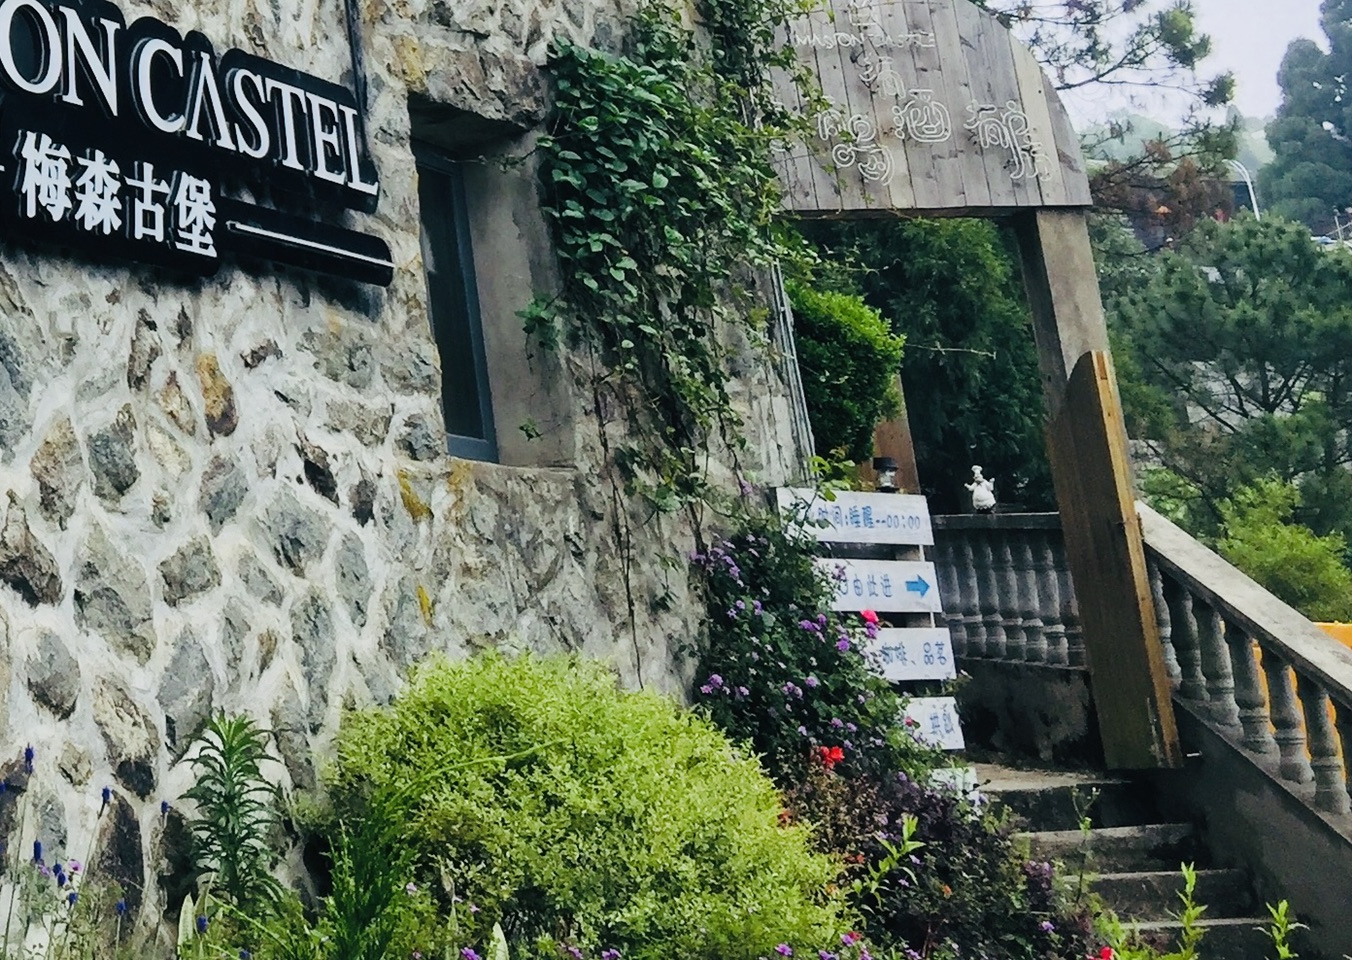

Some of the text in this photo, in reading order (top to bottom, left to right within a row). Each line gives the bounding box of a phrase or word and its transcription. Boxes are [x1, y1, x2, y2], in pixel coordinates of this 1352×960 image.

[137, 36, 379, 196] CASTEL
[20, 130, 219, 259] 梅森古堡
